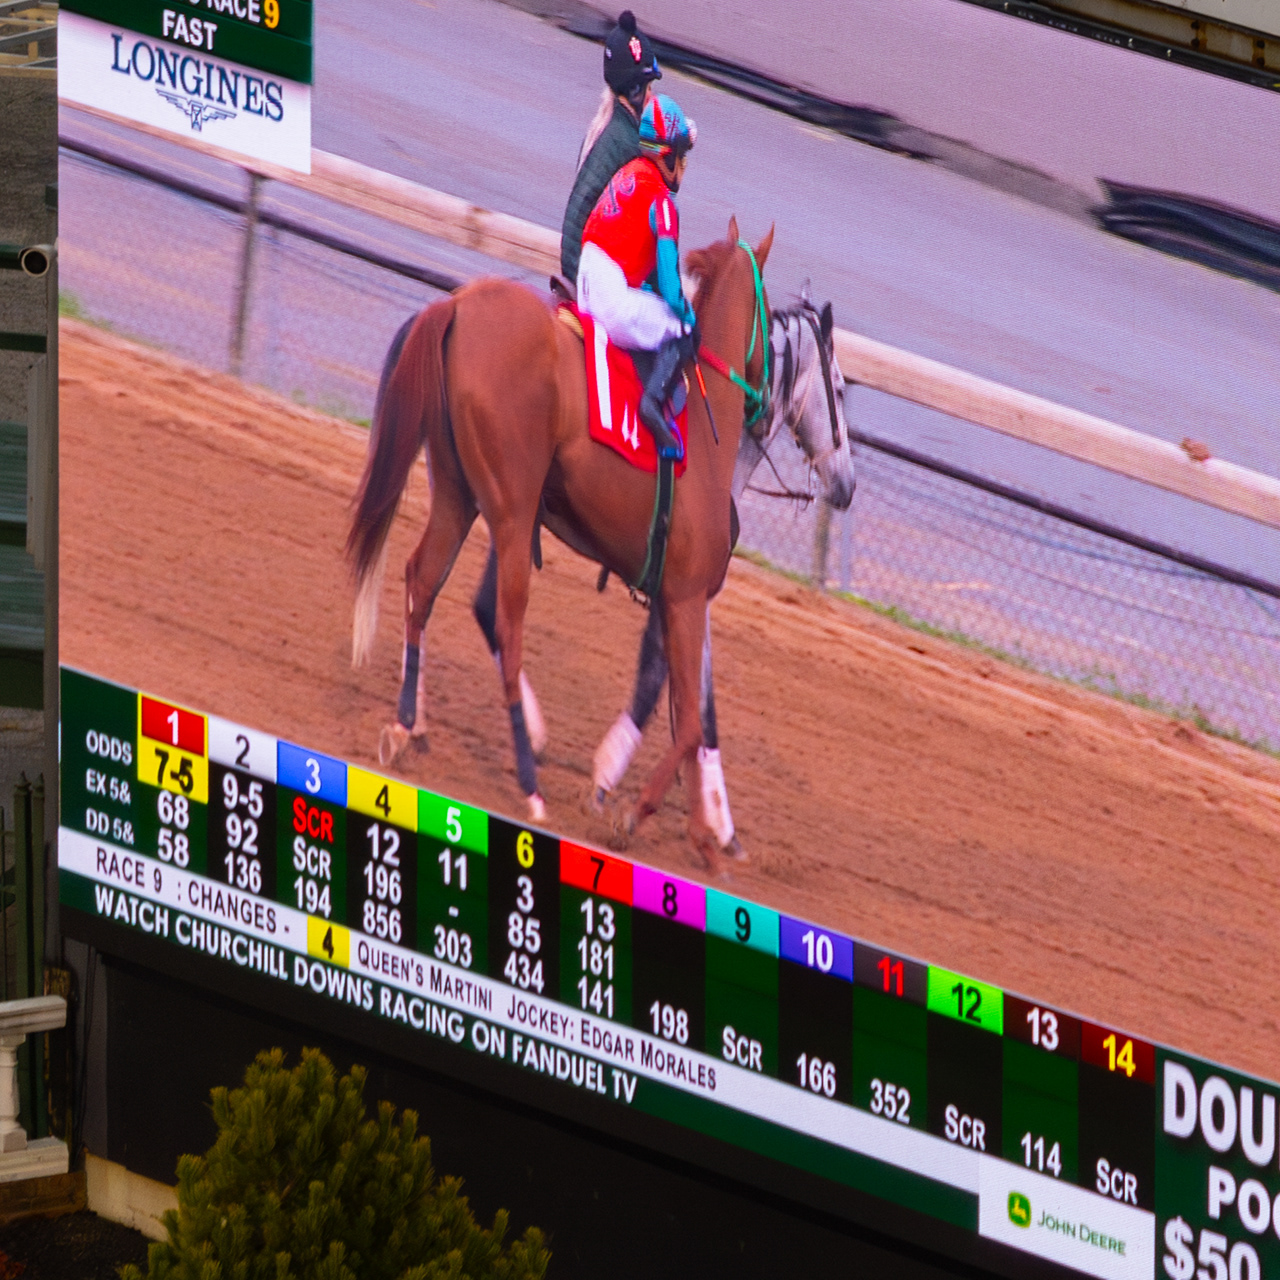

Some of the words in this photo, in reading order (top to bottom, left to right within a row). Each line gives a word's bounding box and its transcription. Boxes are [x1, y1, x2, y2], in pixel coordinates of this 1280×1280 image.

[110, 33, 284, 122] LONGINES
[162, 8, 217, 50] FAST
[86, 729, 132, 765] ODDS
[154, 748, 193, 793] 7-5
[222, 772, 264, 819] 9-5
[292, 796, 334, 843] SCR
[366, 823, 401, 867] 12
[438, 848, 468, 891] 11
[516, 875, 535, 913] 3
[580, 898, 616, 942] 13
[86, 768, 106, 795] EX
[157, 790, 189, 830] 68
[226, 813, 258, 856] 92
[293, 835, 332, 881] SCR
[363, 860, 402, 905] 196
[507, 911, 541, 954] 85
[577, 935, 614, 981] 181
[167, 710, 179, 745] 1
[235, 734, 250, 769] 2
[305, 758, 321, 794] 3
[375, 784, 391, 818] 4
[445, 806, 462, 843] 5
[516, 830, 535, 869] 6
[590, 855, 605, 891] 7
[662, 881, 678, 917] 8
[734, 907, 750, 942] 9
[801, 930, 834, 973] 10
[877, 955, 904, 997] 11
[951, 982, 982, 1024] 12
[1027, 1007, 1059, 1051] 13
[1102, 1033, 1136, 1078] 14
[86, 807, 110, 834] DD
[157, 827, 190, 869] 58
[224, 851, 262, 894] 136
[294, 875, 332, 919] 194
[362, 899, 401, 944] 856
[433, 924, 473, 969] 303
[504, 951, 545, 995] 434
[577, 975, 614, 1020] 141
[650, 1000, 689, 1045] 198
[722, 1025, 763, 1071] SCR
[797, 1052, 837, 1098] 166
[870, 1078, 910, 1125] 352
[945, 1104, 986, 1151] SCR
[1021, 1131, 1062, 1178] 114
[1096, 1157, 1138, 1205] SCR
[94, 883, 169, 937] WATCH
[175, 914, 288, 980] CHURCHILL
[294, 956, 374, 1011] DOWNS
[380, 987, 465, 1044] RACING
[471, 1021, 506, 1058] ON
[512, 1034, 606, 1095] FANDUEL
[611, 1069, 637, 1104] TV
[97, 847, 145, 888] RACE
[153, 868, 163, 893] 9
[188, 880, 276, 934] CHANGES
[322, 925, 334, 959] 4
[357, 940, 424, 990] QUEEN'S
[430, 965, 492, 1013] MARTINI
[507, 993, 575, 1042] JOCKEY:
[581, 1018, 635, 1063] EDGAR
[640, 1039, 717, 1092] MORALES
[1037, 1209, 1076, 1238] JOHN
[1079, 1224, 1126, 1257] DEERE
